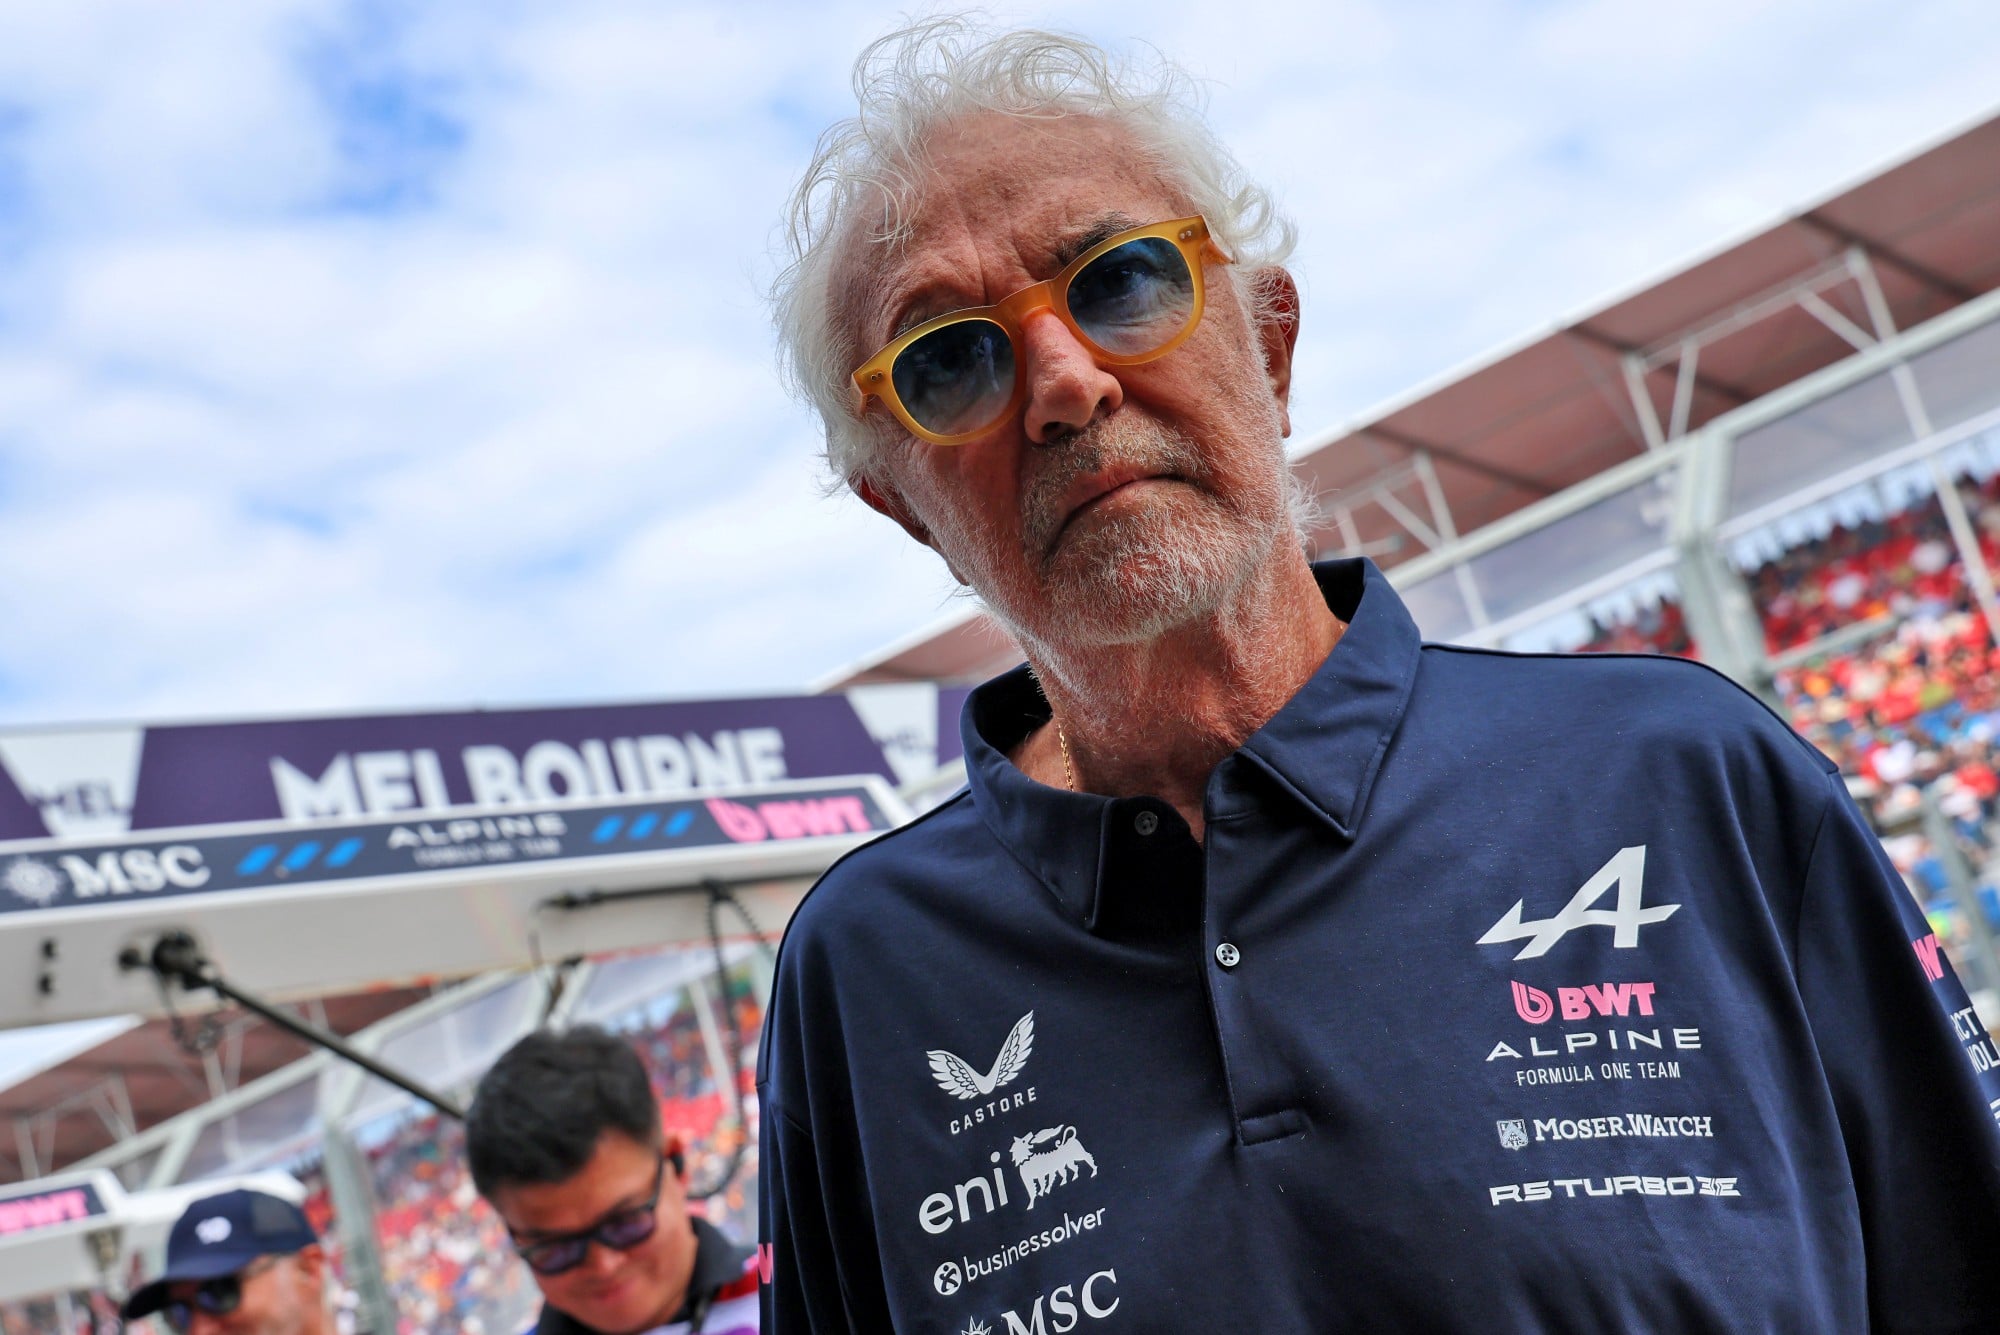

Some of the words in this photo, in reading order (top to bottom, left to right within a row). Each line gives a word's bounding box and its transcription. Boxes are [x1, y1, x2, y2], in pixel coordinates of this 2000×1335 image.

[387, 812, 567, 849] ALPINE
[59, 845, 211, 898] MSC
[1557, 982, 1656, 1020] BWT
[1486, 1028, 1702, 1062] ALPINE
[1516, 1065, 1595, 1086] FORMULA
[1601, 1062, 1632, 1080] ONE
[1637, 1061, 1681, 1079] TEAM
[950, 1087, 1037, 1135] CASTORE
[918, 1151, 1009, 1235] eni
[964, 1207, 1107, 1282] businessolver
[1001, 1268, 1120, 1335] MSC
